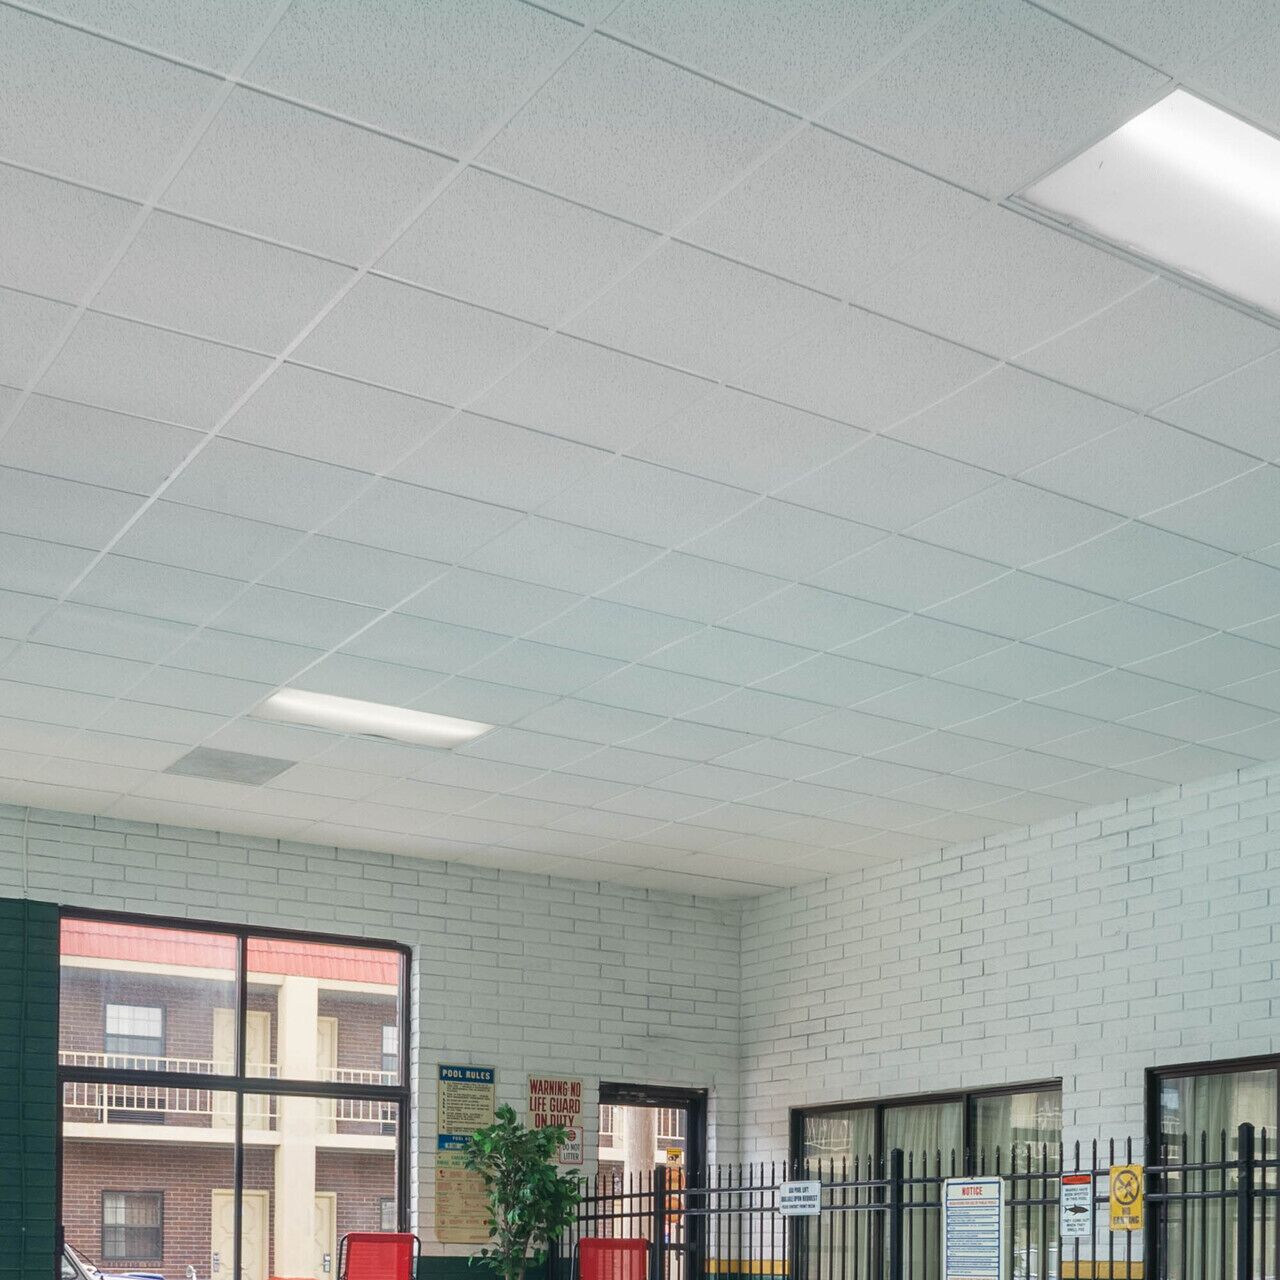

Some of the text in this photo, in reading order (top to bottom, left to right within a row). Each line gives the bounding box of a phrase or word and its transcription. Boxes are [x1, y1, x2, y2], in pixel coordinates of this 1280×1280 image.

[442, 1069, 491, 1080] POOL RULES
[530, 1097, 581, 1113] LIFE GUARD
[535, 1113, 575, 1128] ON DUTY
[563, 1152, 580, 1160] LITTER
[962, 1186, 983, 1196] NOTICE
